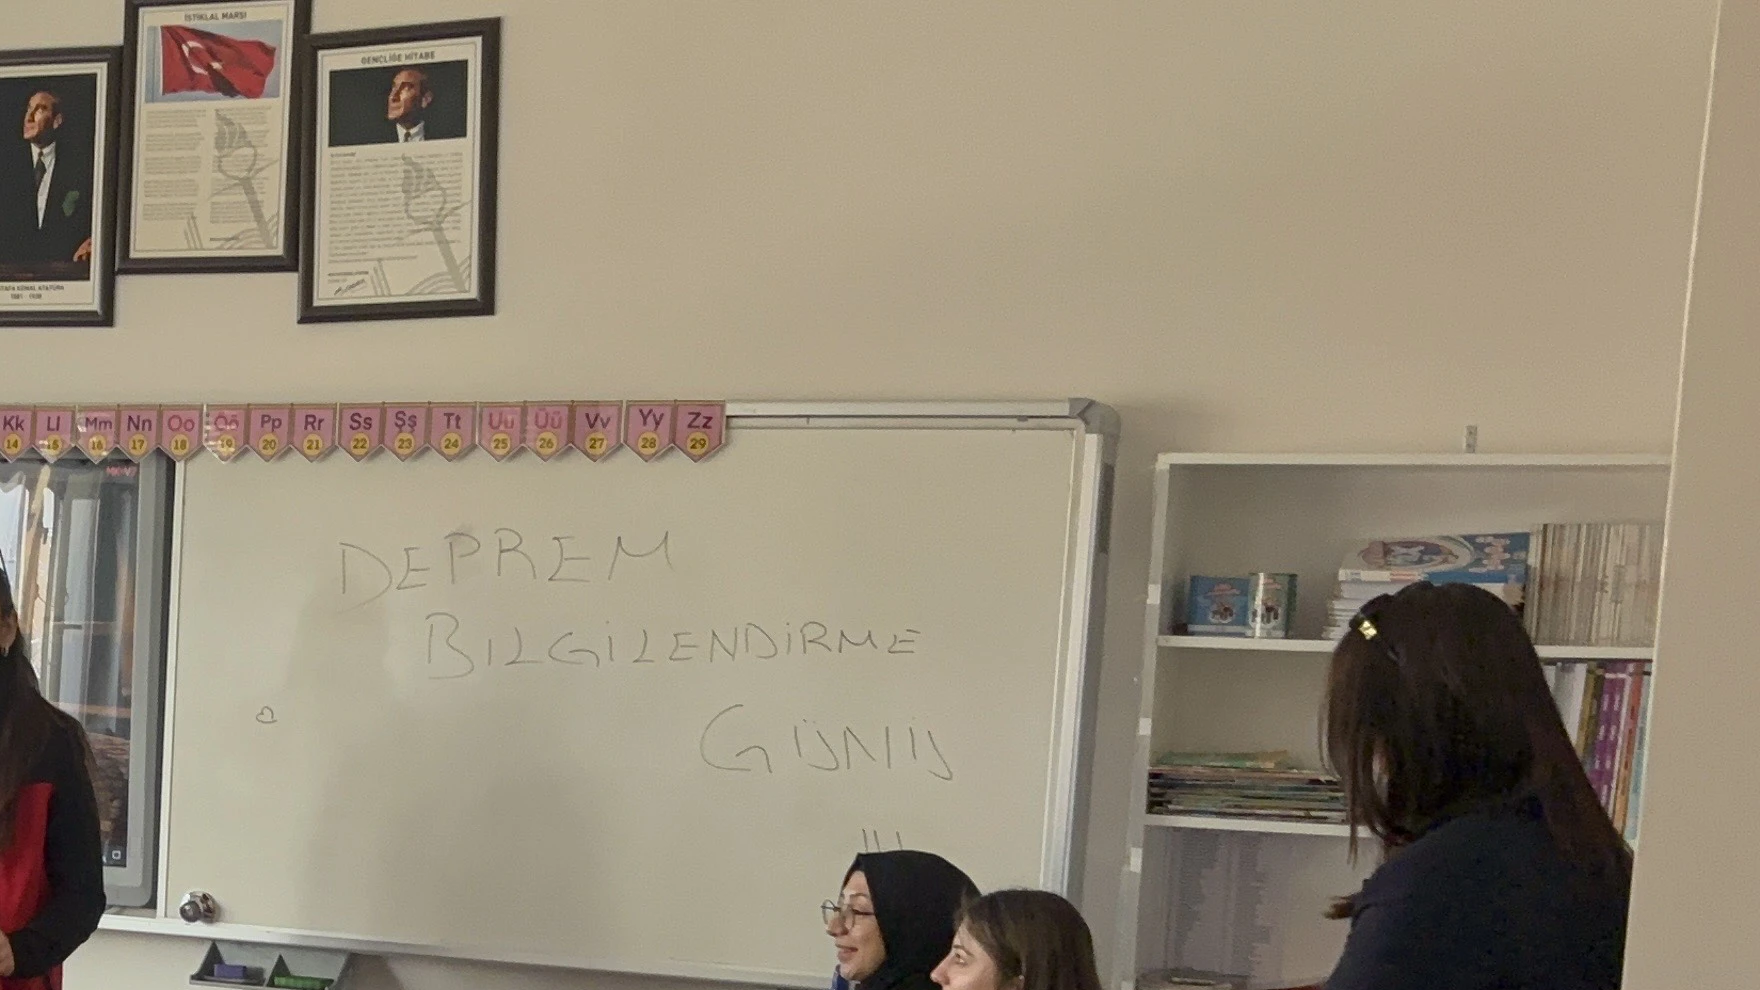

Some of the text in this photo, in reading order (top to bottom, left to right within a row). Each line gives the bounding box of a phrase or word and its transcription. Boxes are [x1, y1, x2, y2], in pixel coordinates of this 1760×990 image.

[3, 415, 25, 431] Kk
[47, 416, 61, 431] Ll
[85, 416, 113, 431] Mm
[127, 414, 152, 432] Nn
[167, 414, 196, 432] Oo
[261, 413, 282, 432] Pp
[303, 414, 325, 431] Rr
[349, 412, 372, 430] Ss
[394, 410, 417, 433] Şş
[443, 412, 462, 430] Tt
[489, 411, 514, 430] Uu
[584, 412, 611, 429] Vv
[639, 408, 664, 431] Yy
[687, 411, 713, 429] Zz
[6, 439, 19, 450] 14
[131, 438, 145, 450] 17
[173, 439, 187, 451] 18
[262, 439, 277, 450] 20
[306, 439, 320, 450] 21
[352, 438, 368, 450] 22
[398, 438, 413, 450] 23
[444, 438, 459, 450] 24
[493, 438, 508, 450] 25
[539, 437, 554, 449] 26
[589, 437, 605, 449] 27
[640, 437, 657, 449] 28
[690, 437, 707, 449] 29
[336, 527, 674, 615] DEPREM
